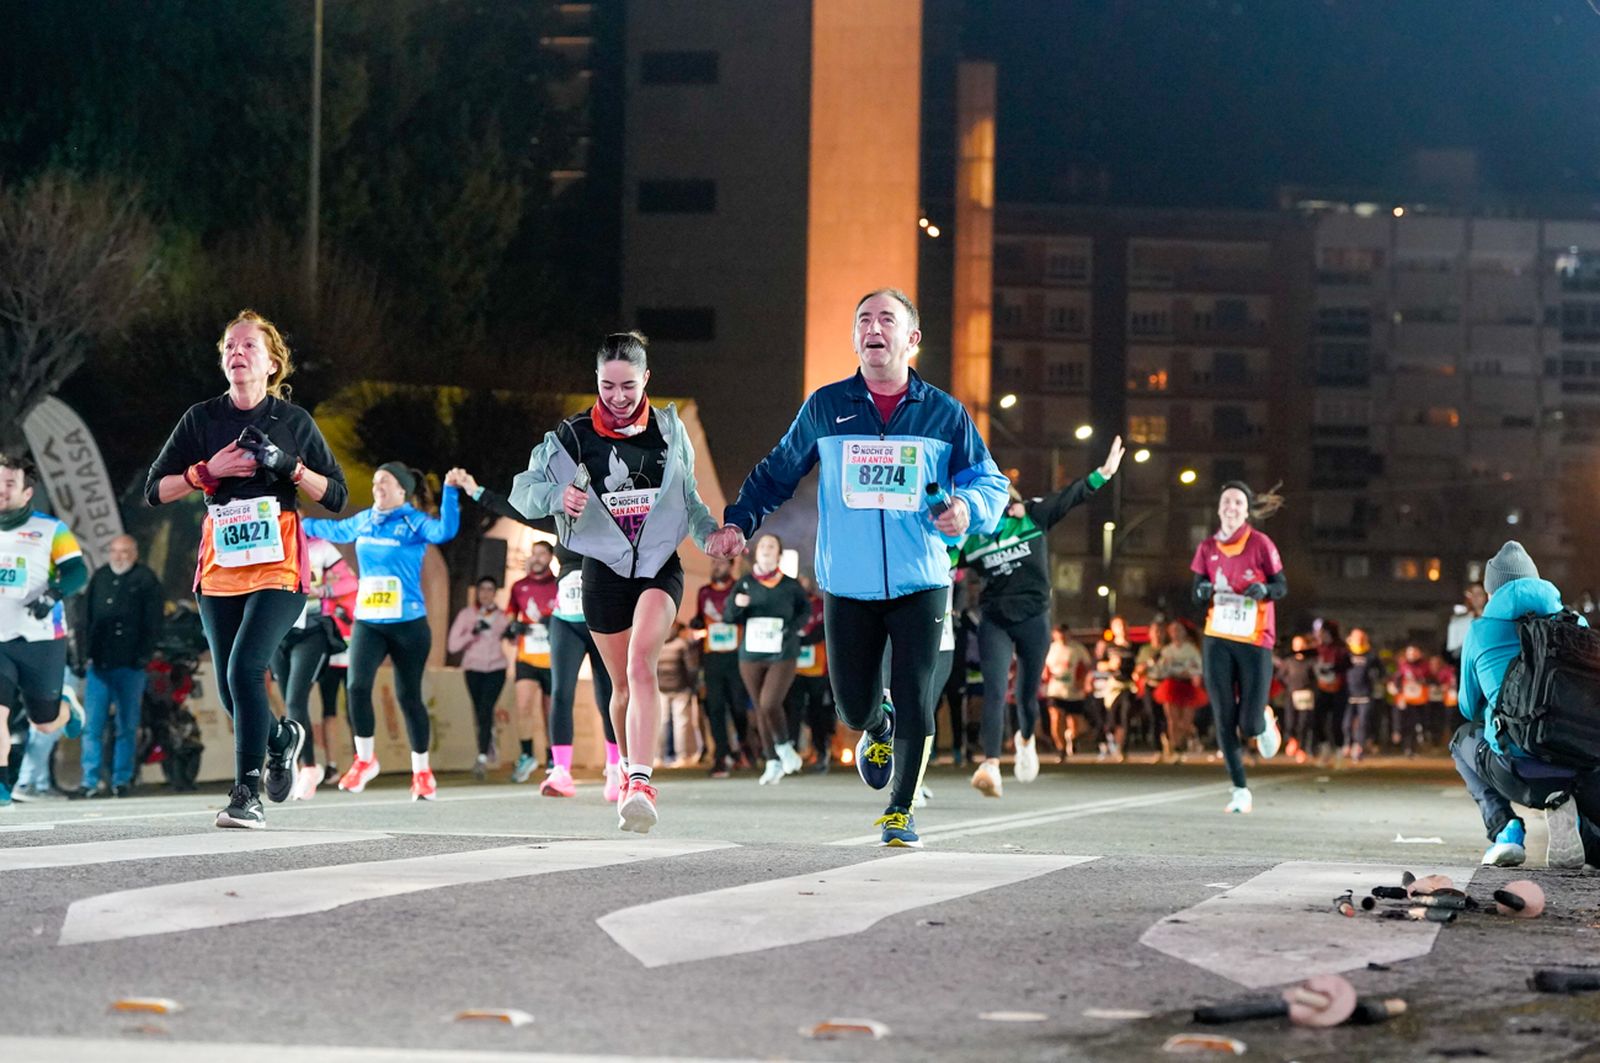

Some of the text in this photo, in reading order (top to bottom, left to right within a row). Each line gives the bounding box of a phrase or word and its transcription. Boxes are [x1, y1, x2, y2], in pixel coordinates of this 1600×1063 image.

[851, 456, 867, 464] SAN
[859, 465, 906, 486] 8274
[619, 498, 639, 506] NOCHE
[641, 496, 649, 504] DE
[222, 507, 241, 516] NOCHE
[611, 507, 624, 515] SAN
[222, 521, 270, 546] 13427
